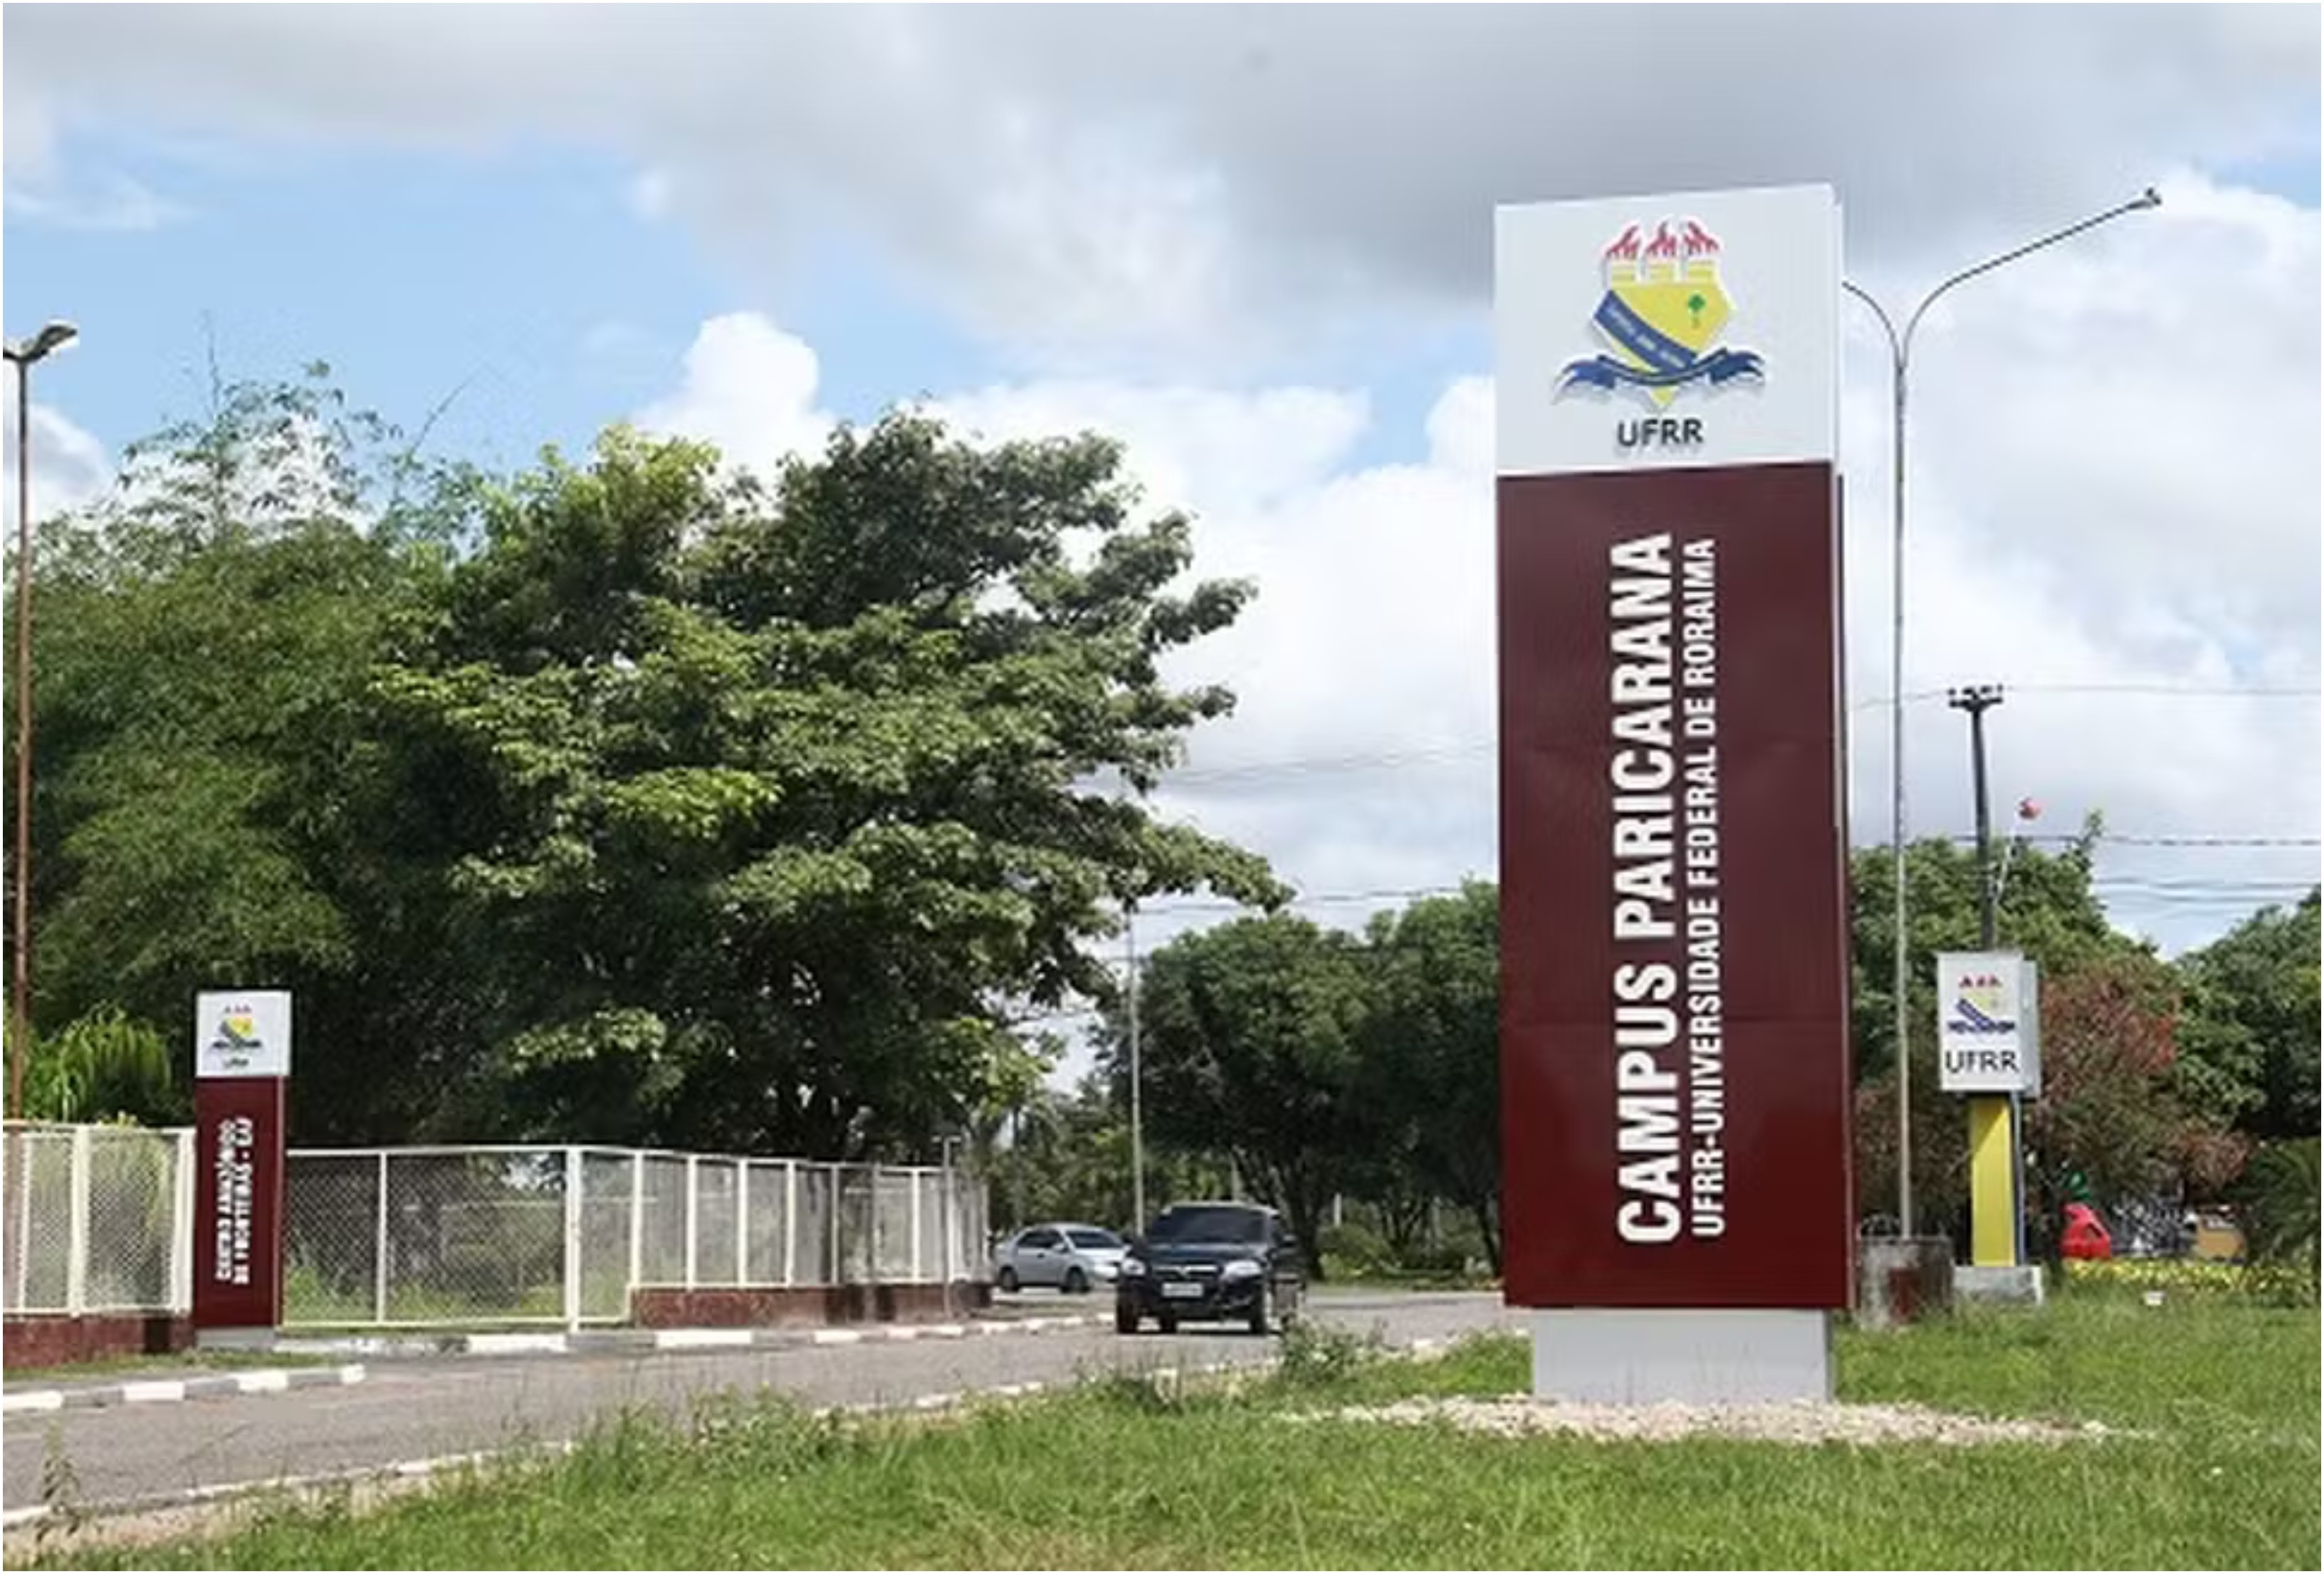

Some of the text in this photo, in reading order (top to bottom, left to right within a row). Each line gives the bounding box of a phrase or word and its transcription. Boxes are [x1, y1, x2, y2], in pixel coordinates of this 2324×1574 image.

[1617, 419, 1704, 447] UFRR
[1610, 532, 1681, 1242] CAMPUS PARICARANA
[1682, 539, 1725, 1237] UFRR-UNIVERSIDADE FEDERAL DE RORAIMA
[1945, 1050, 2019, 1073] UFRR
